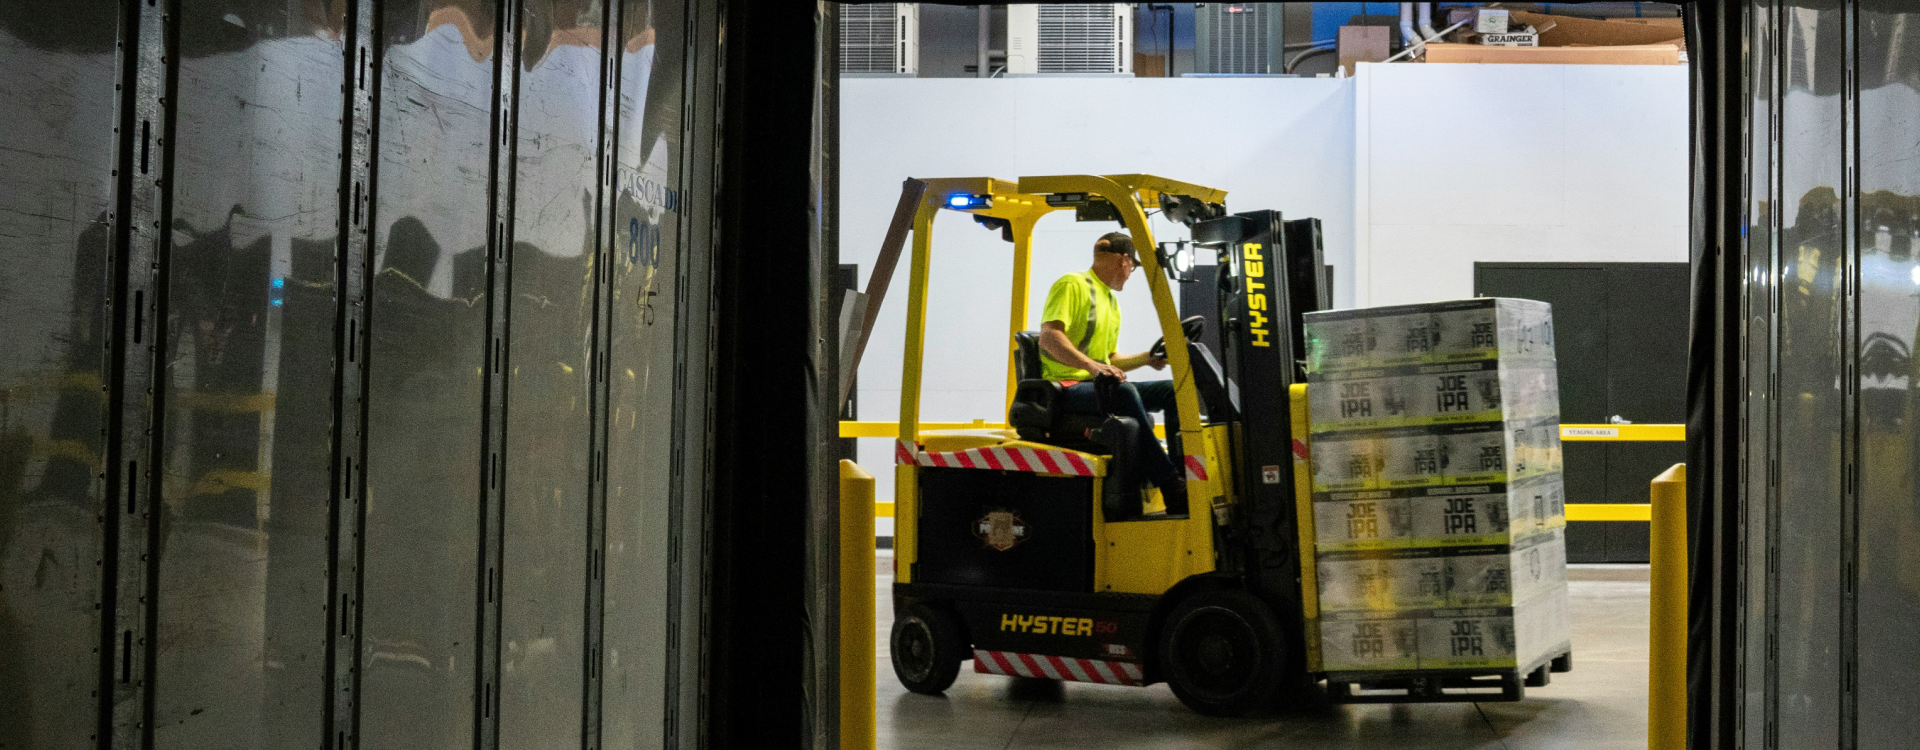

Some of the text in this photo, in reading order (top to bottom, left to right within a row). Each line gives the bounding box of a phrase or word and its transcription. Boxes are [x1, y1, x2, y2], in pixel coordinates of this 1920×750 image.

[1487, 35, 1533, 43] GRAINGER
[629, 217, 660, 269] 800
[1243, 242, 1270, 347] HYSTER
[1471, 323, 1492, 334] JOE
[1472, 334, 1494, 348] IPA
[1341, 382, 1370, 398] JOE
[1437, 375, 1467, 391] JOE
[1341, 399, 1372, 418] IPA
[1437, 391, 1469, 412] IPA
[1481, 457, 1502, 471] IPA
[1346, 503, 1376, 518] JOE
[1444, 498, 1475, 513] JOE
[1347, 518, 1378, 538] IPA
[1445, 514, 1476, 534] IPA
[1001, 614, 1094, 636] HYSTER
[1352, 623, 1382, 638] JOE
[1450, 621, 1482, 636] JOE
[1353, 639, 1383, 658] IPA
[1451, 637, 1483, 656] IPA
